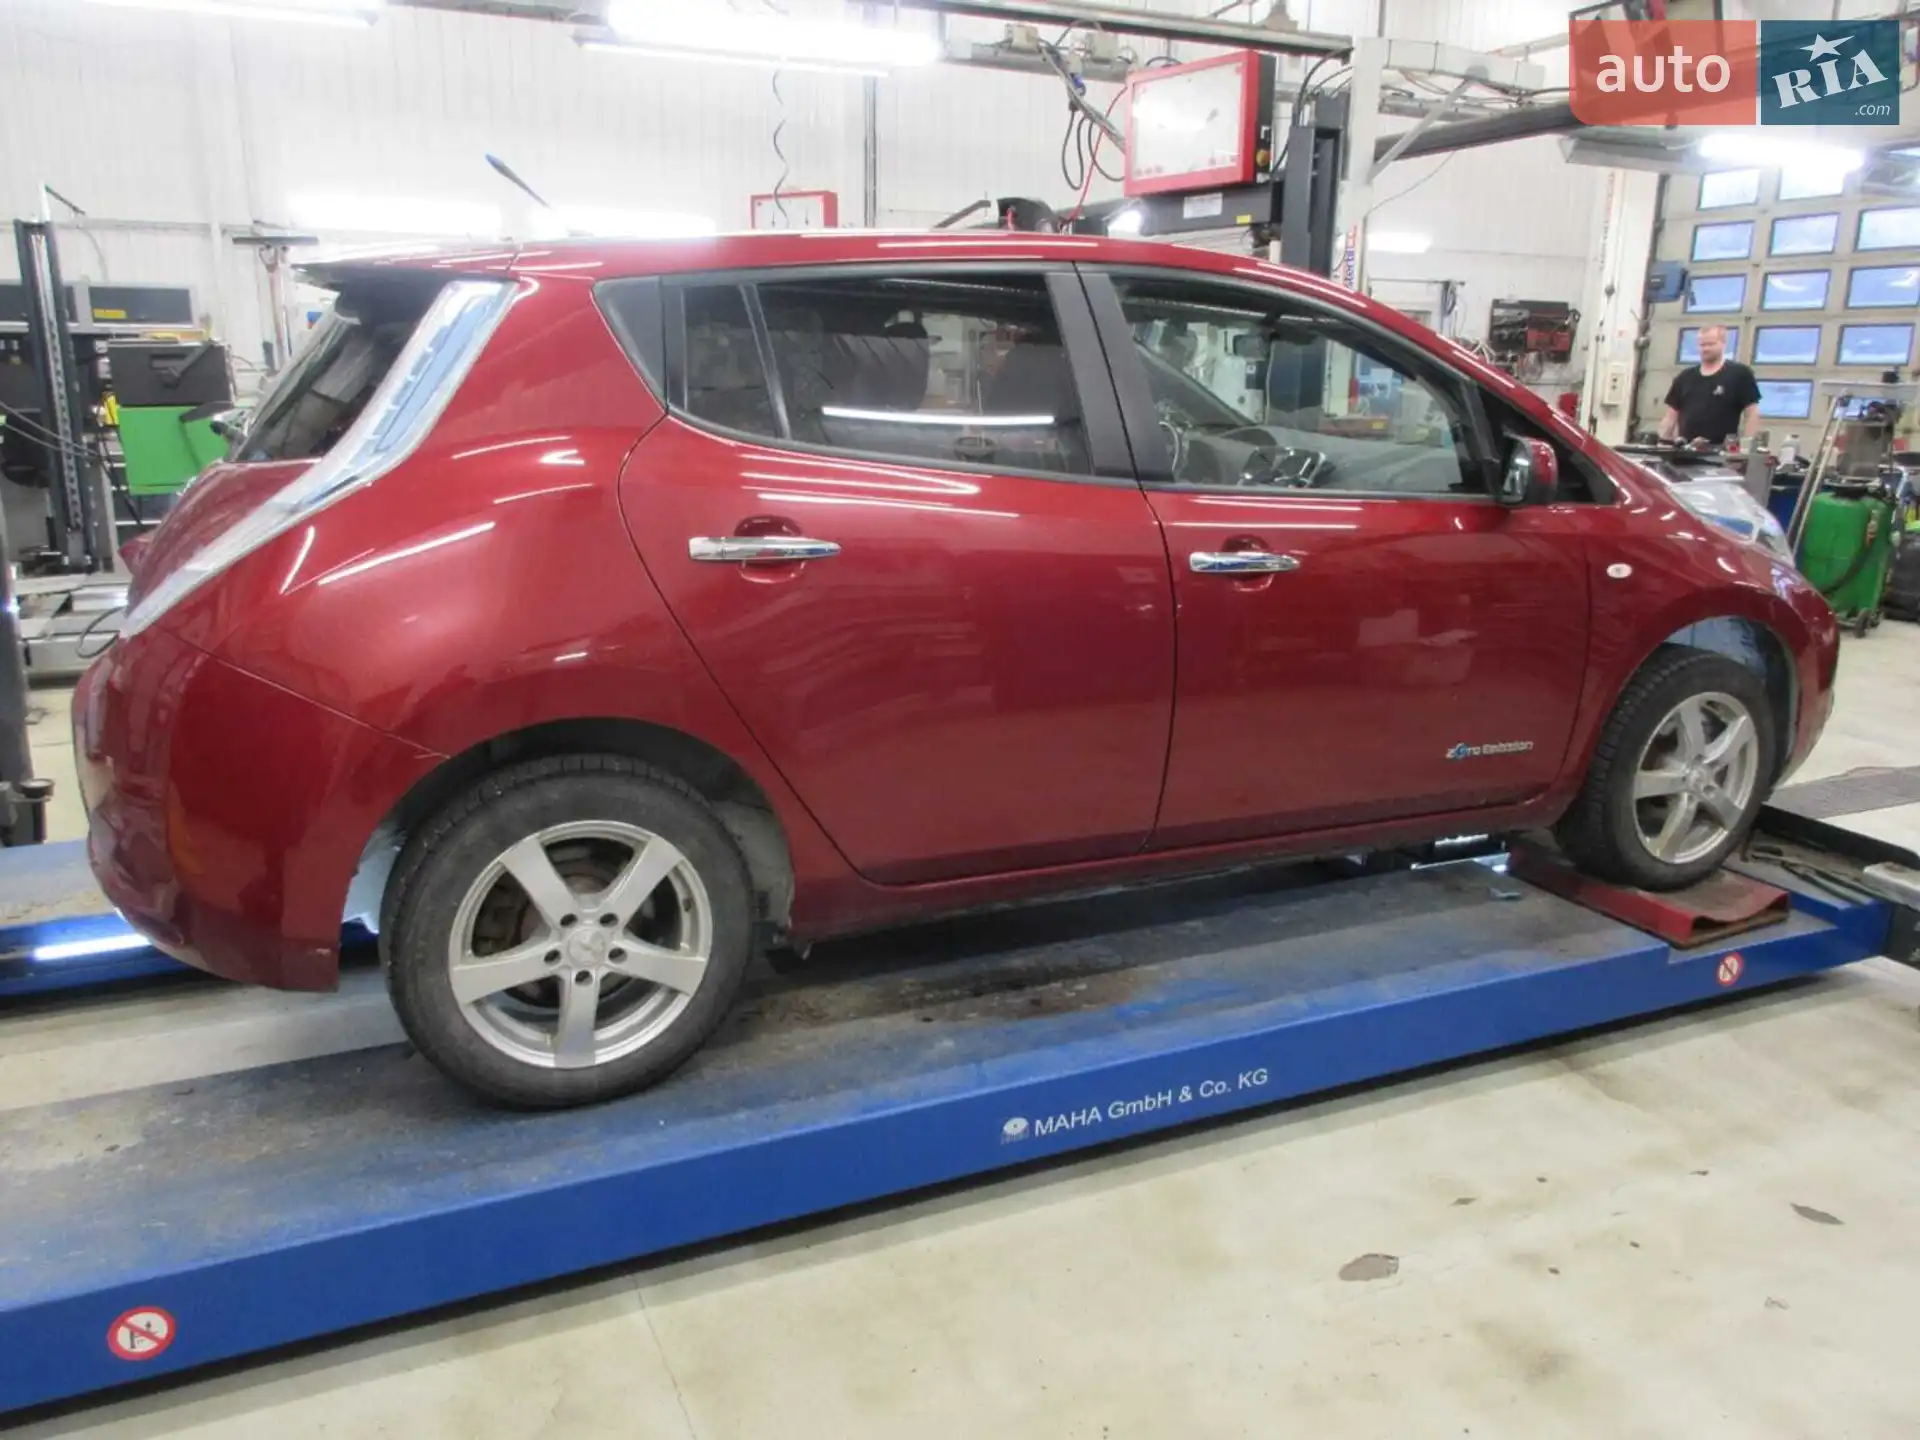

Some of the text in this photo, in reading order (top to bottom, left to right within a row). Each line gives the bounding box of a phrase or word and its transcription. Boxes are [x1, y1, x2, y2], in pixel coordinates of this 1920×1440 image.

[1034, 1068, 1268, 1137] MAHA GmbH & Co. KG
